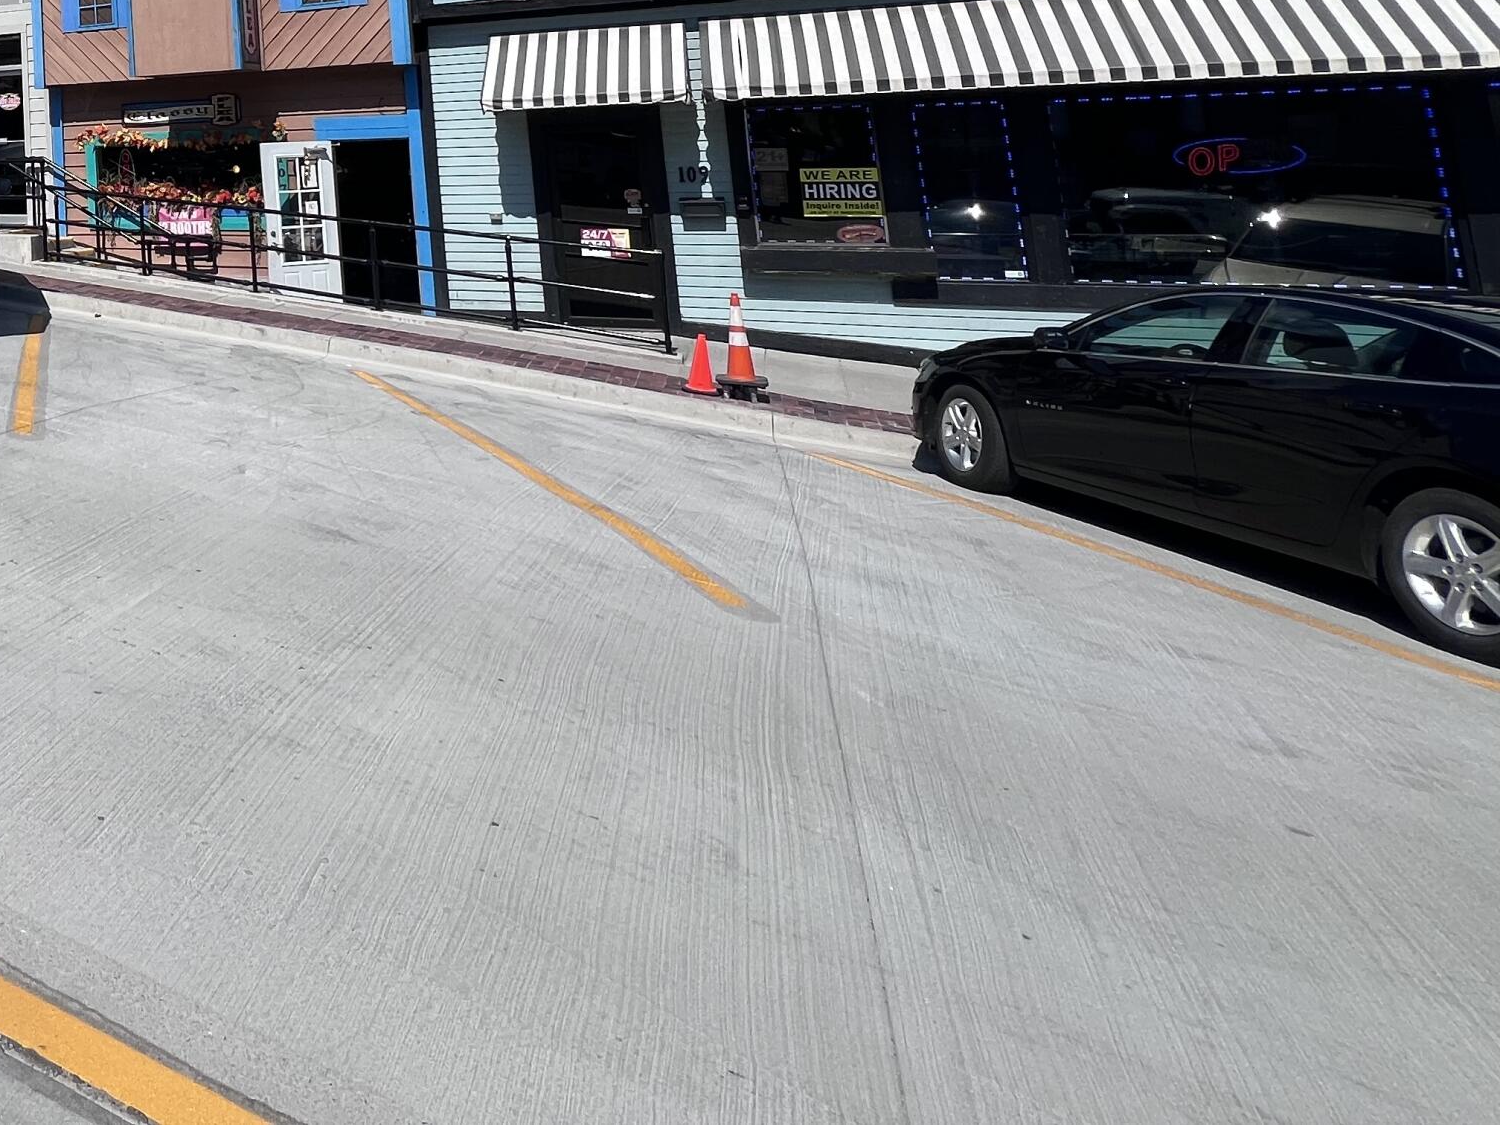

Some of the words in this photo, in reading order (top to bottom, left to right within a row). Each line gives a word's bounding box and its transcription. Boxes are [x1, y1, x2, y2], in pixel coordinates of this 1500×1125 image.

[126, 105, 210, 121] Classy
[677, 165, 709, 185] 109
[803, 170, 831, 180] WE
[836, 170, 873, 181] ARE
[804, 183, 877, 199] HIRING
[806, 202, 842, 212] Inquire
[844, 202, 880, 210] Inside!
[582, 229, 608, 240] 24/7
